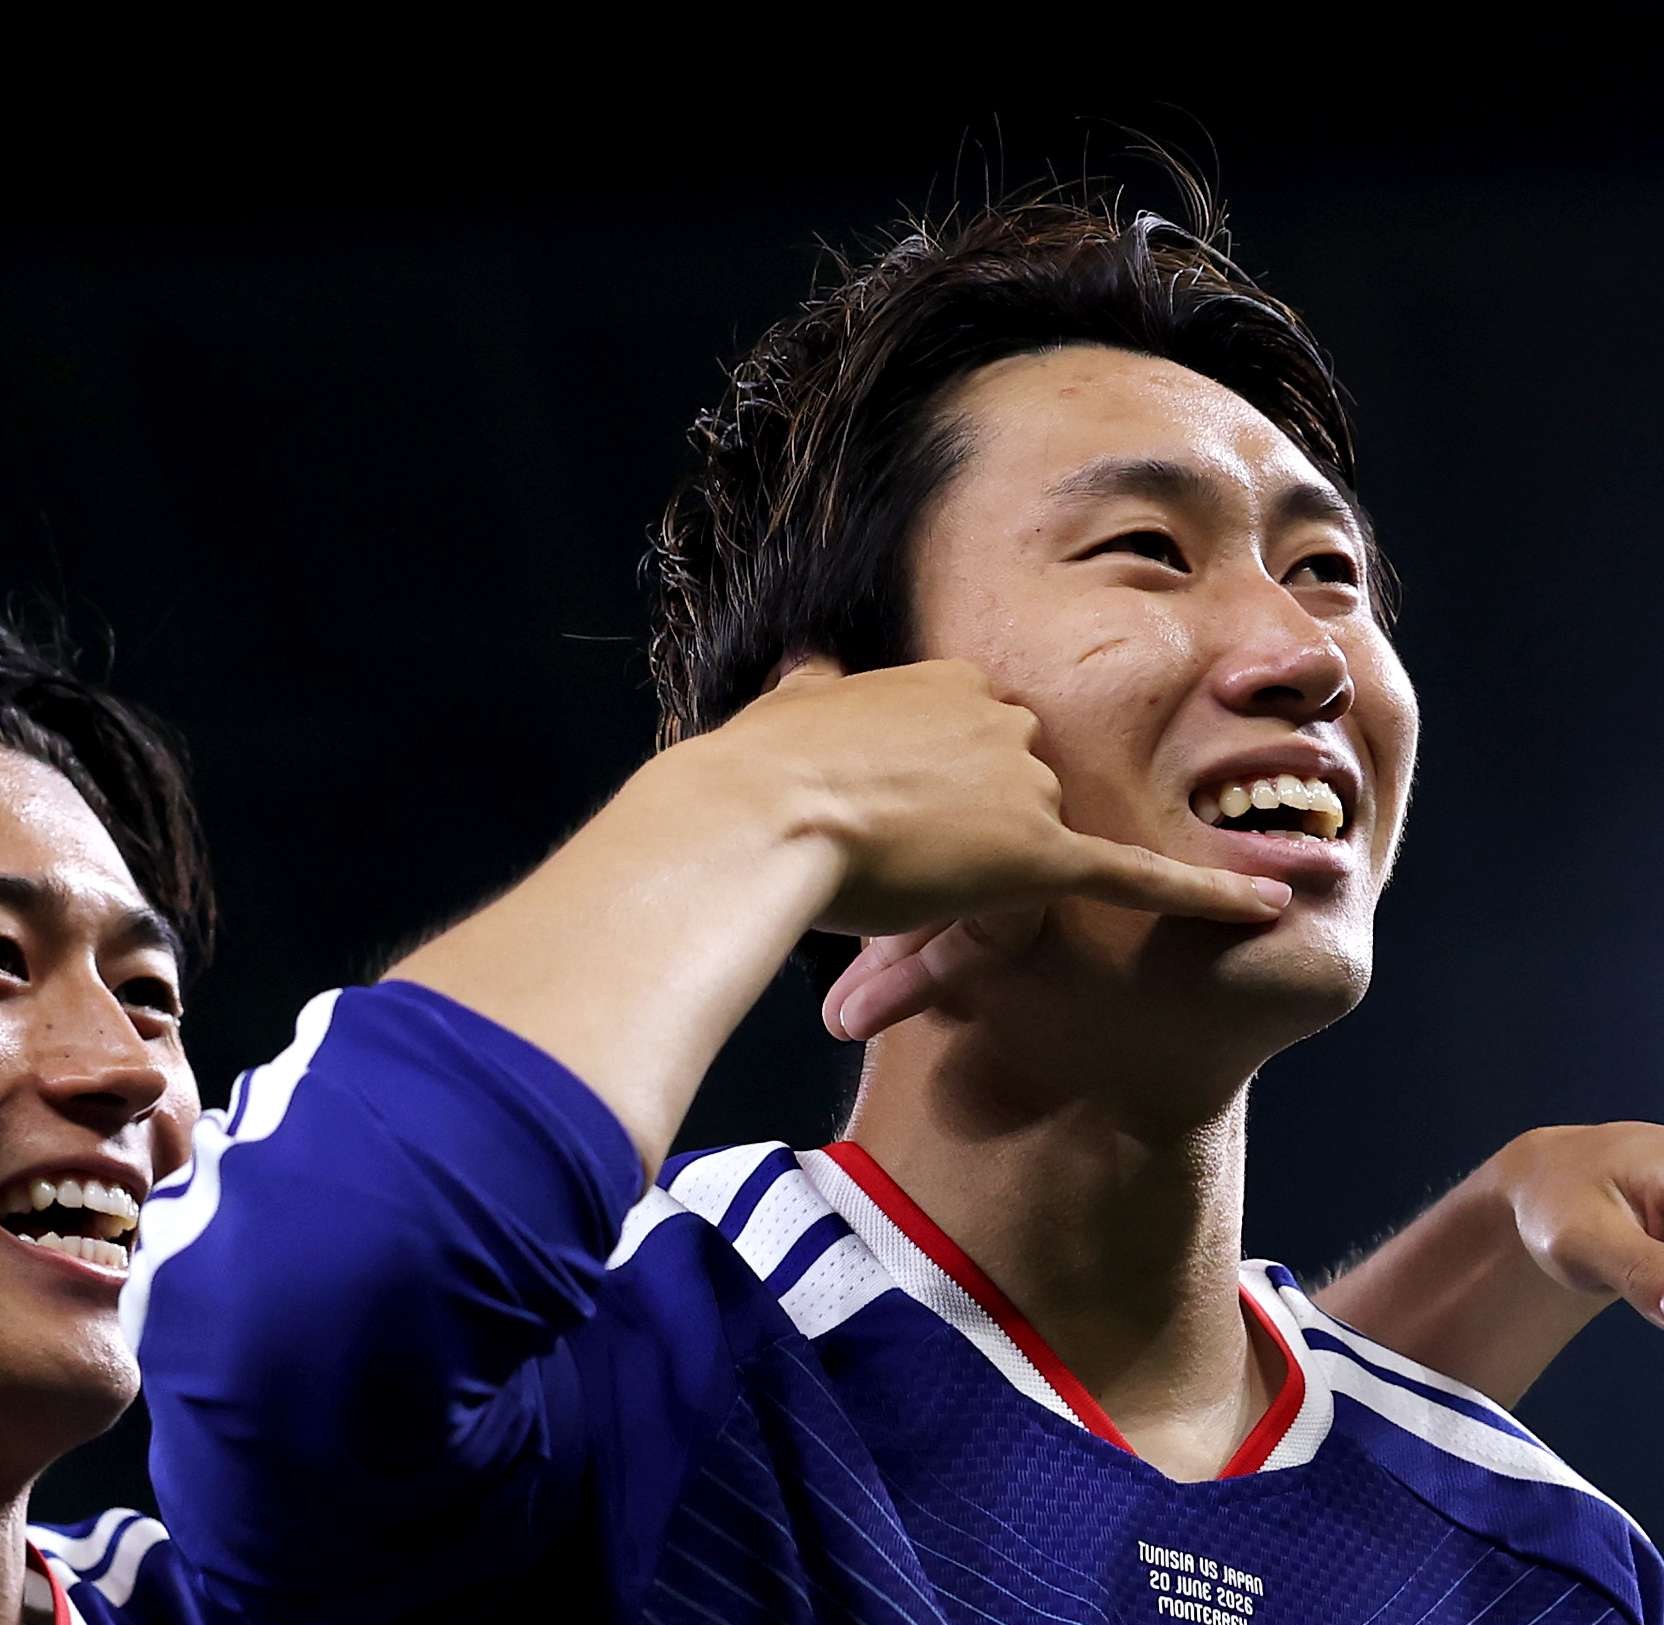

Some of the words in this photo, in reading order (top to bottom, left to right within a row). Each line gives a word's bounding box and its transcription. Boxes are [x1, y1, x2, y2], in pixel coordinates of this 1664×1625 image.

[1137, 1540, 1195, 1574] TUNISIA
[1222, 1565, 1264, 1597] JAPAN
[1149, 1569, 1170, 1592] 20
[1175, 1575, 1212, 1602] JUNE
[1216, 1586, 1254, 1616] 2026
